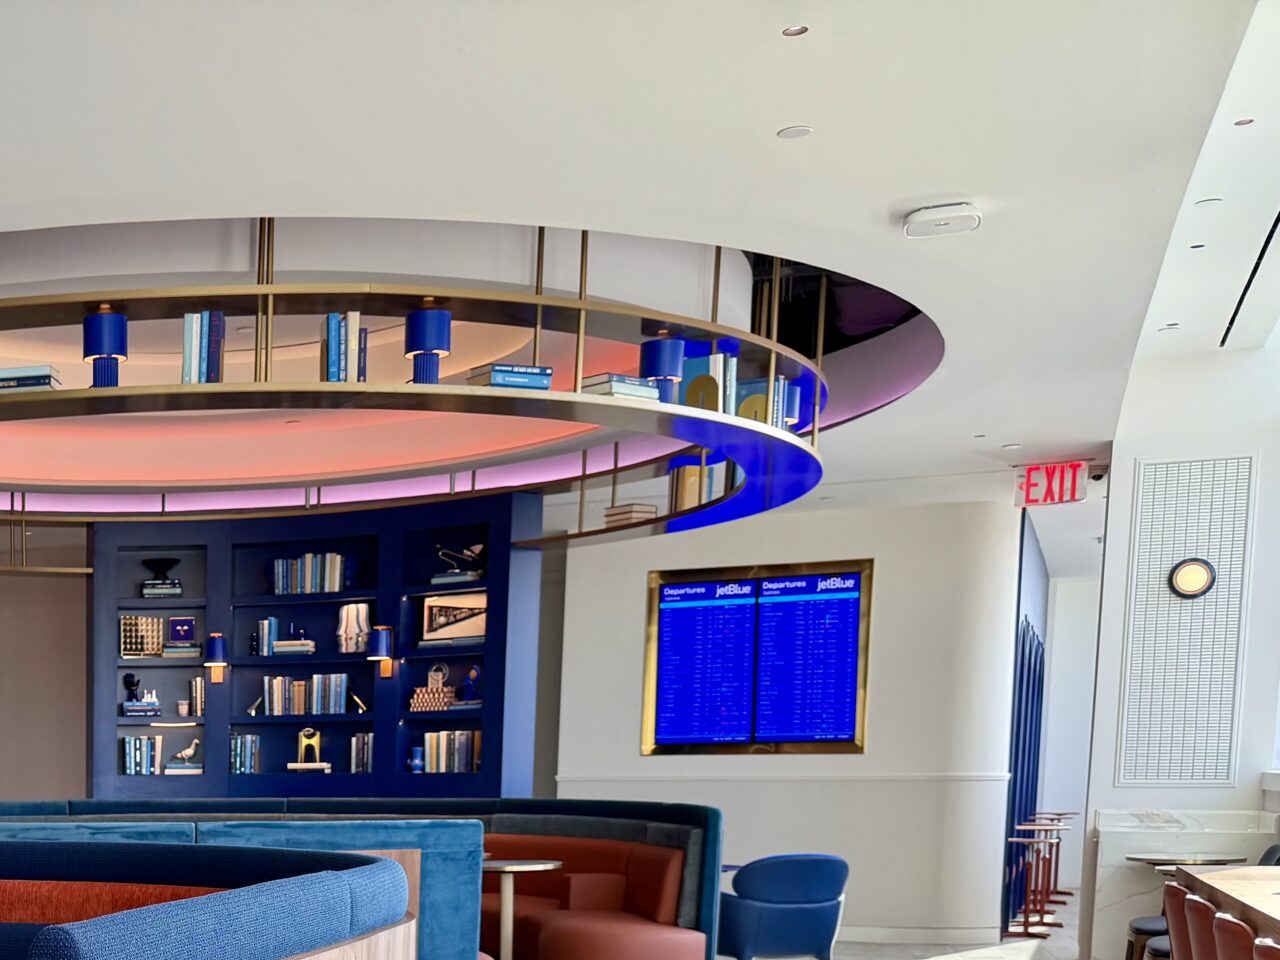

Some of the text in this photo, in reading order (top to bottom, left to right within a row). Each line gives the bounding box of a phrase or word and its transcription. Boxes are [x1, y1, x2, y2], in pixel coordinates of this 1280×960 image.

[1025, 461, 1085, 504] EXIT
[663, 587, 706, 596] Departures
[715, 583, 752, 598] jetBlue
[762, 580, 807, 590] Departures
[816, 577, 855, 592] jetBlue
